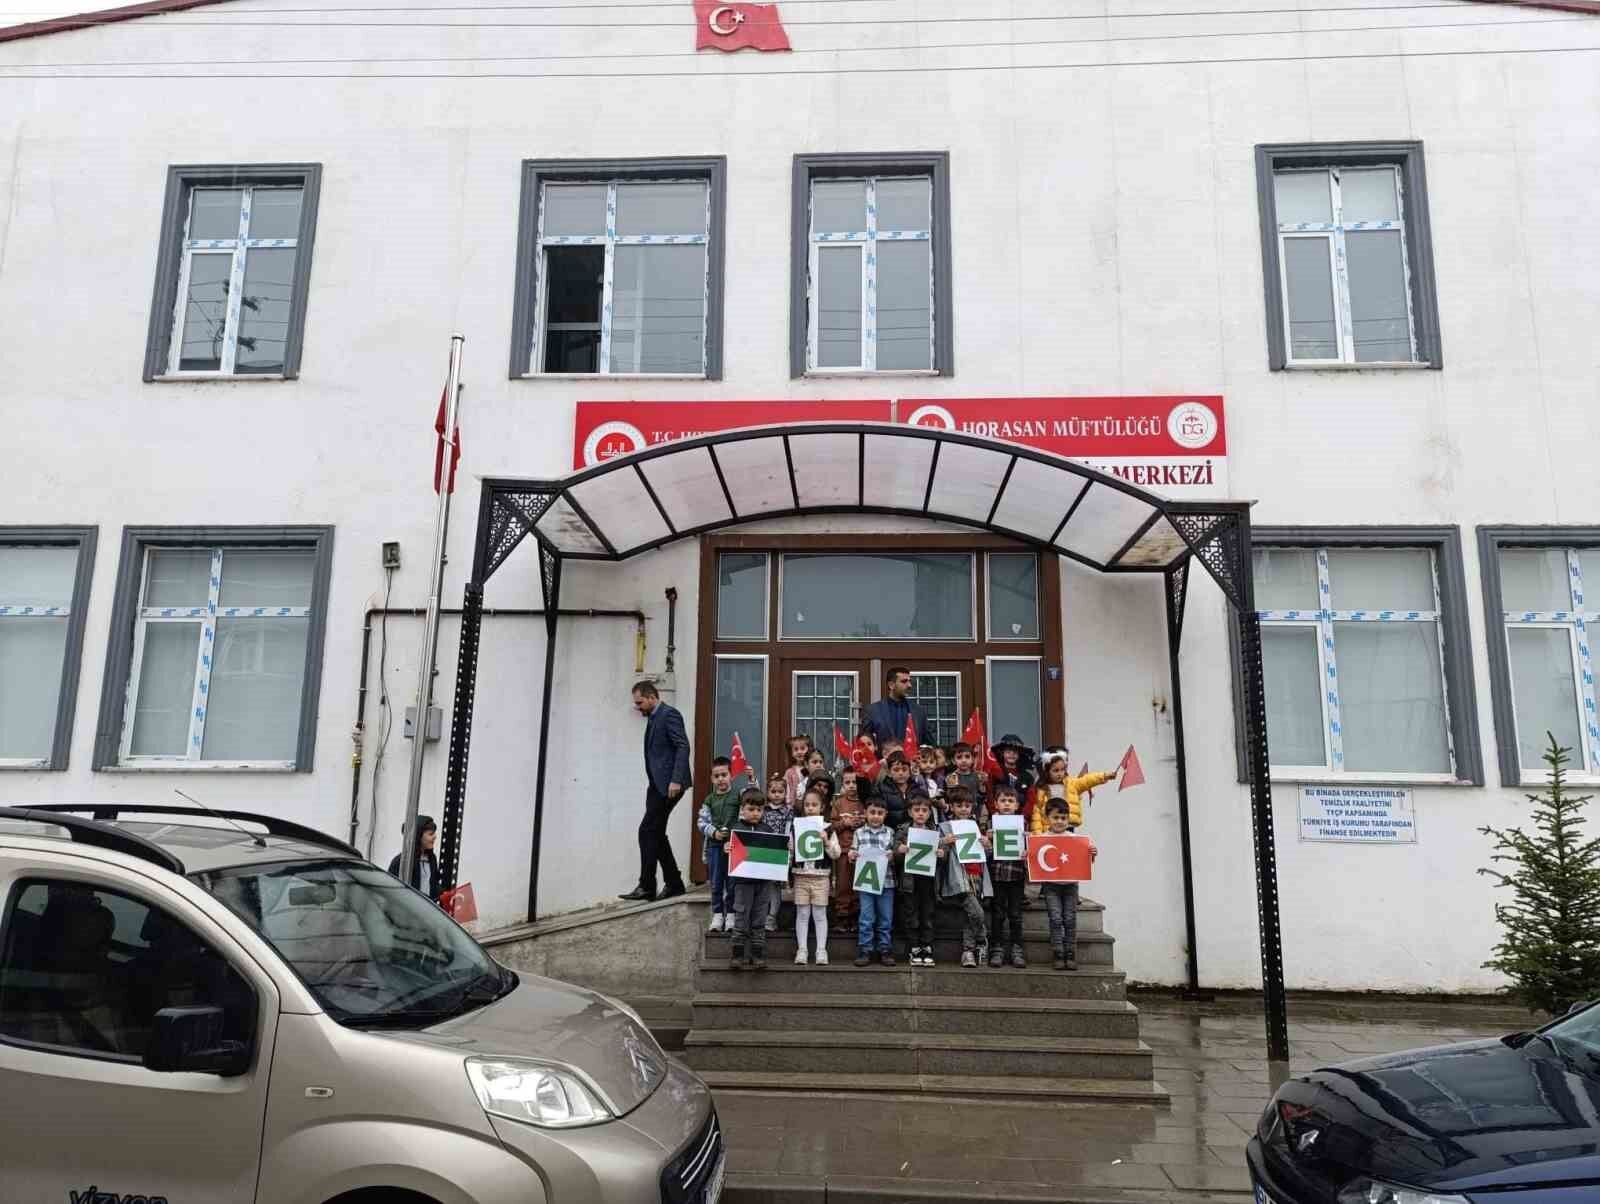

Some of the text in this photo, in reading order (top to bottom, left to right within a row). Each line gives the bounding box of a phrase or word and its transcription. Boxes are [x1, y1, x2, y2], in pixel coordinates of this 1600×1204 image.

[962, 416, 1161, 438] HORASAN MÜFTÜLÜĞÜ
[1111, 459, 1214, 485] MERKEZİ
